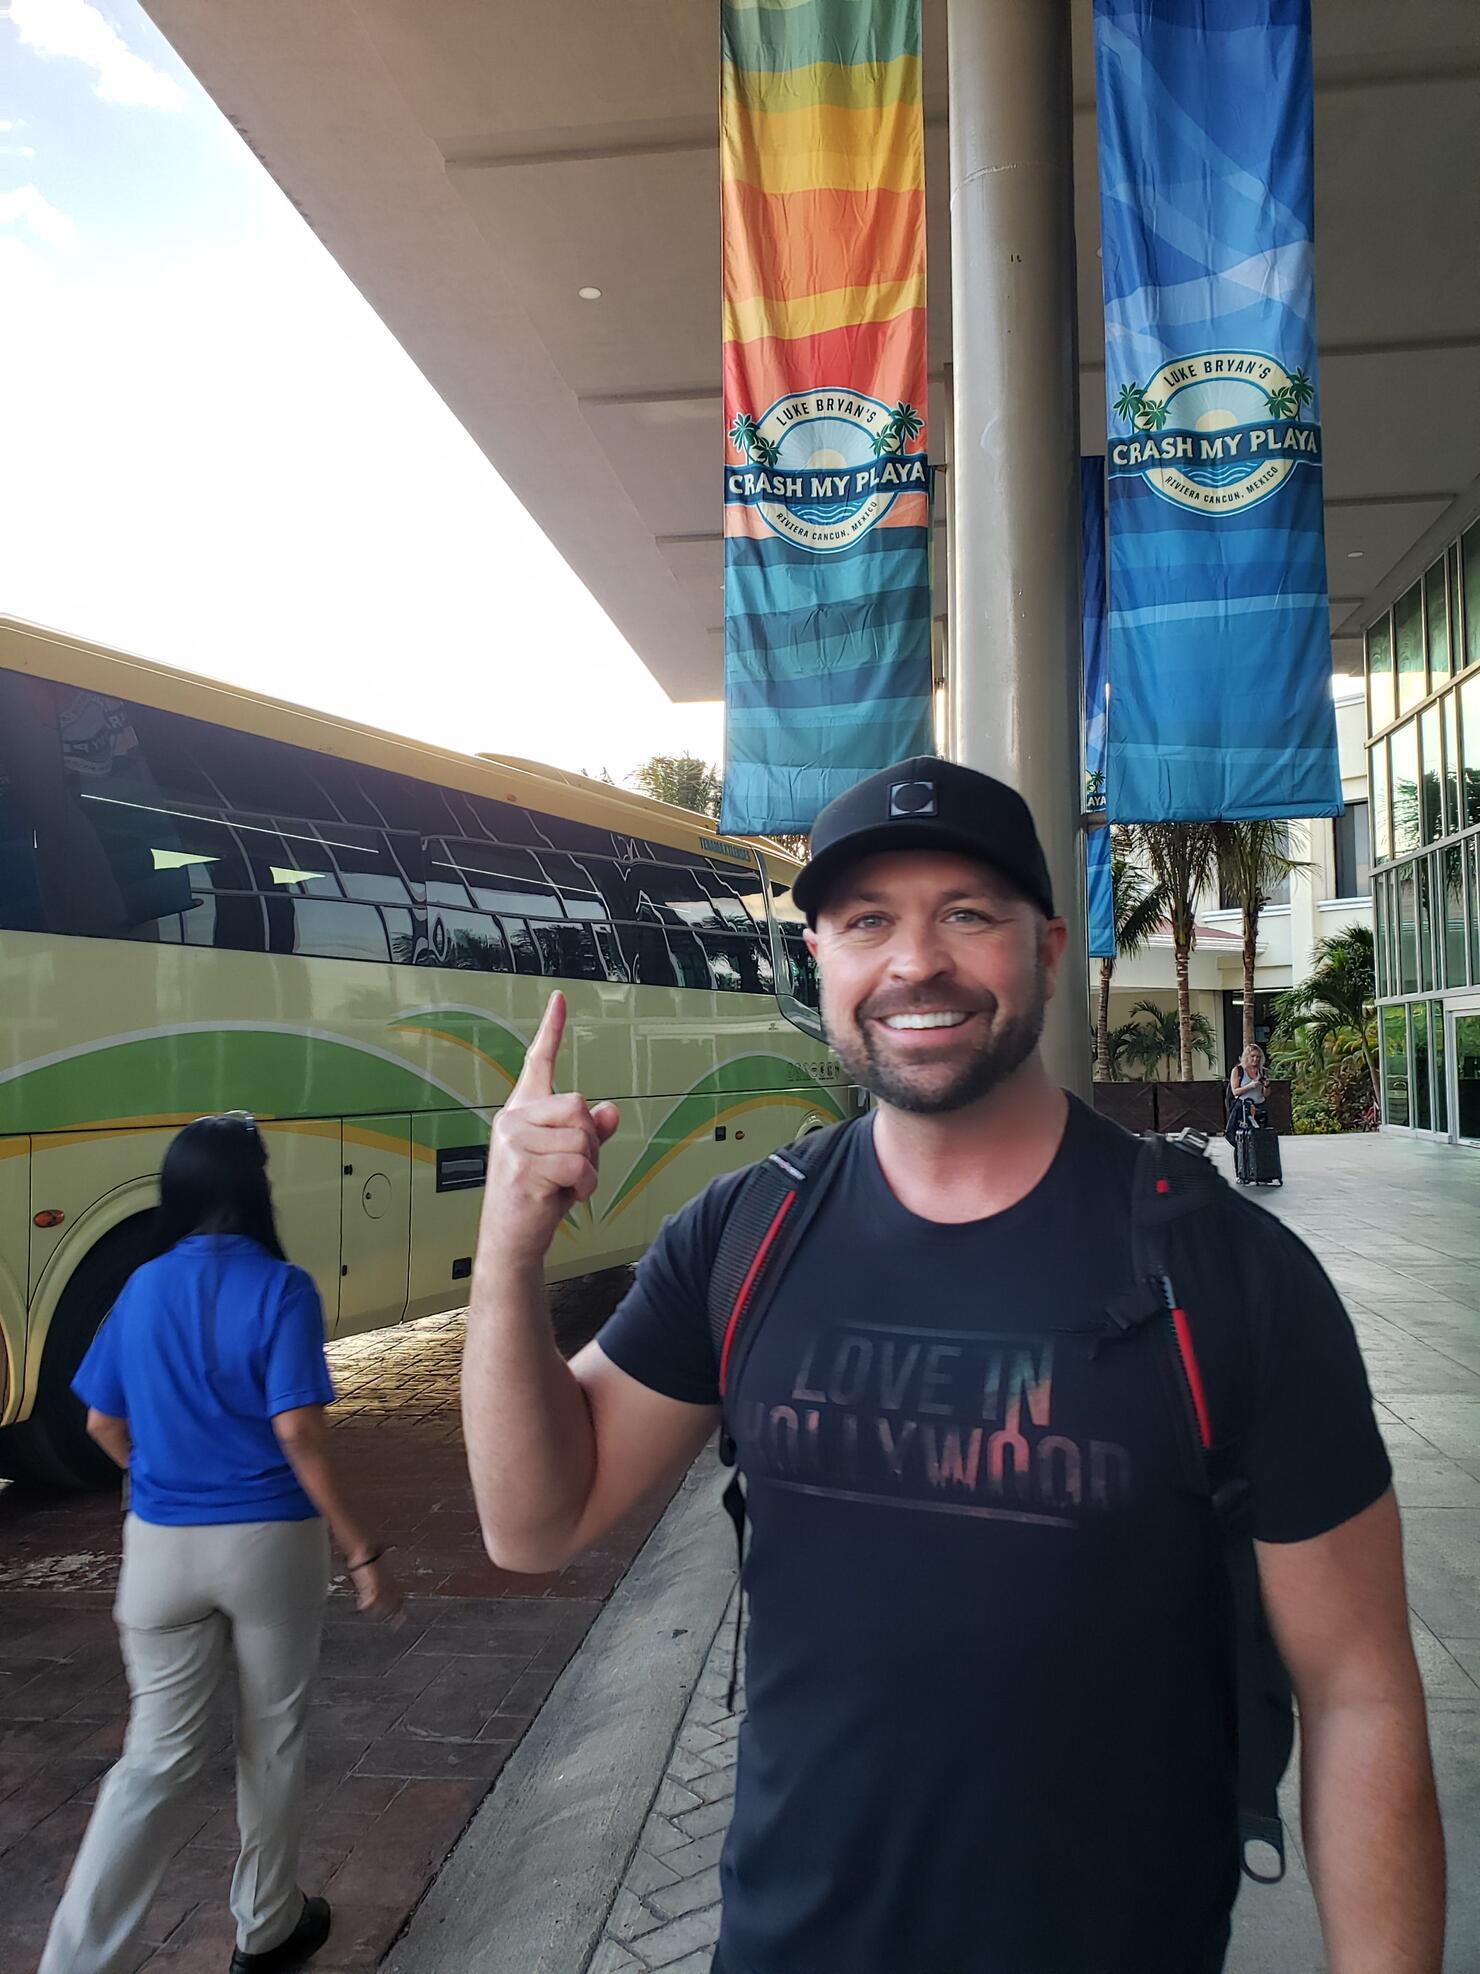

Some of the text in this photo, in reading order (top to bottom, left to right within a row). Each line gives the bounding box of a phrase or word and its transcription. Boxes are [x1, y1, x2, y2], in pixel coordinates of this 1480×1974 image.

[1165, 360, 1271, 387] LUKE BRYAN'S
[776, 399, 877, 426] LUKE BRYAN'S
[1113, 428, 1317, 465] CRASH MY PLAYA
[729, 462, 926, 497] CRASH MY PLAYA
[1165, 476, 1199, 500] RIVIERA
[1247, 466, 1278, 494] MEXICO
[776, 513, 809, 538] RIVIERA
[852, 502, 877, 531] MEXICO
[1088, 796, 1107, 806] AYA
[791, 1333, 1055, 1428] LOVE IN
